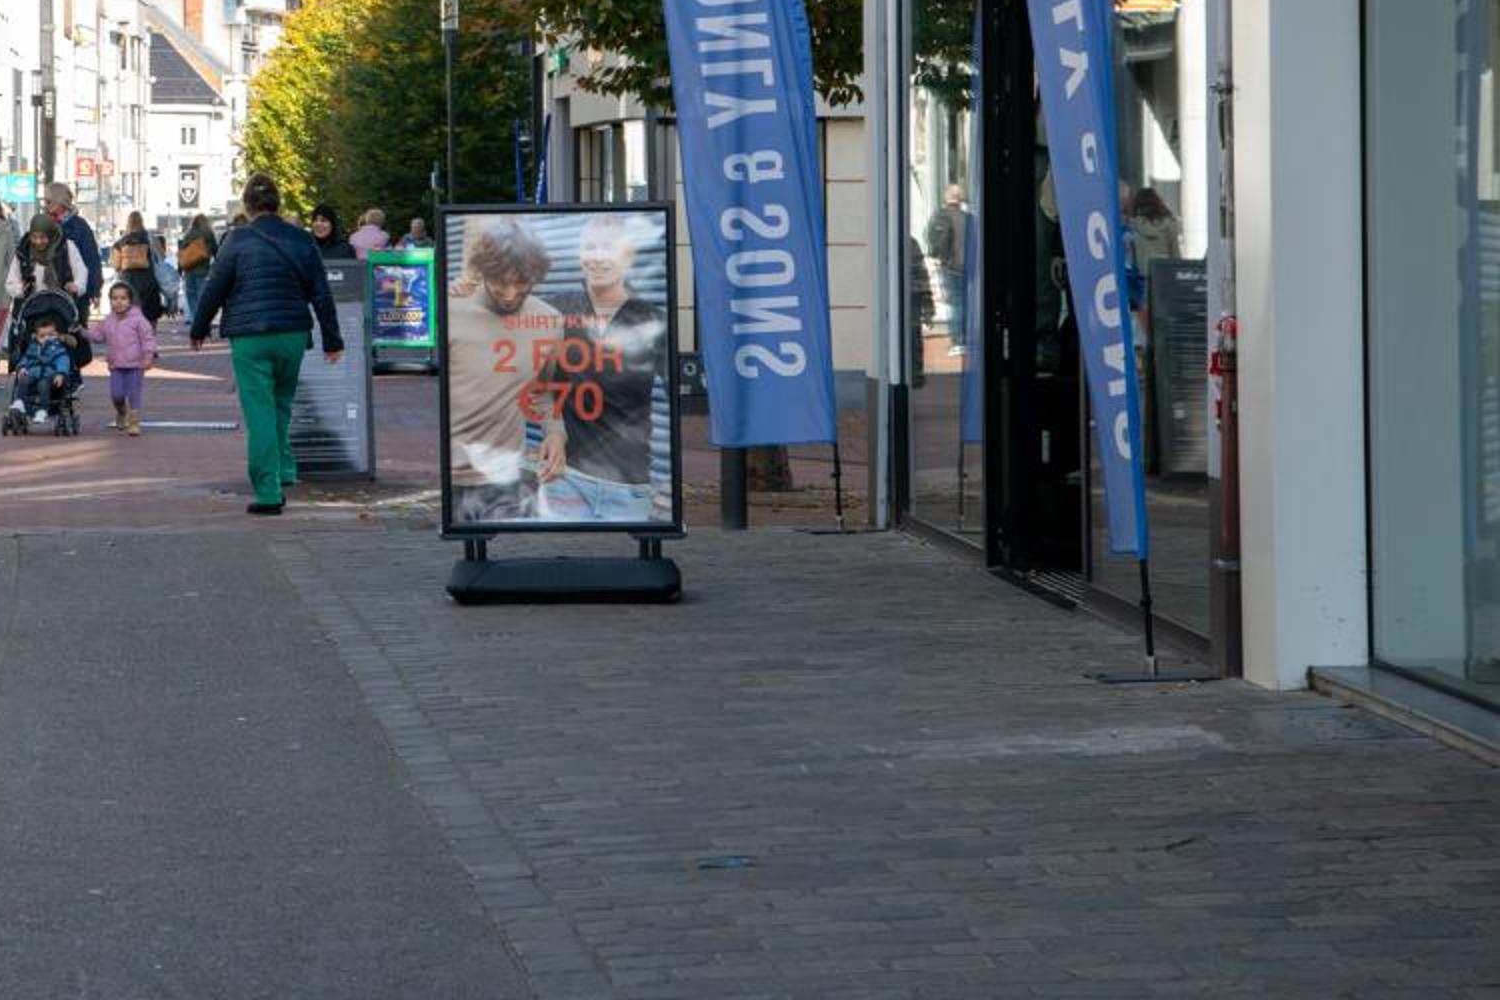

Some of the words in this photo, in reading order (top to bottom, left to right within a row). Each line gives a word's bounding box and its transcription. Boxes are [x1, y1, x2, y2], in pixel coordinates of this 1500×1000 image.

[492, 340, 517, 373] 2
[532, 339, 623, 373] FOR
[517, 382, 604, 421] €70
